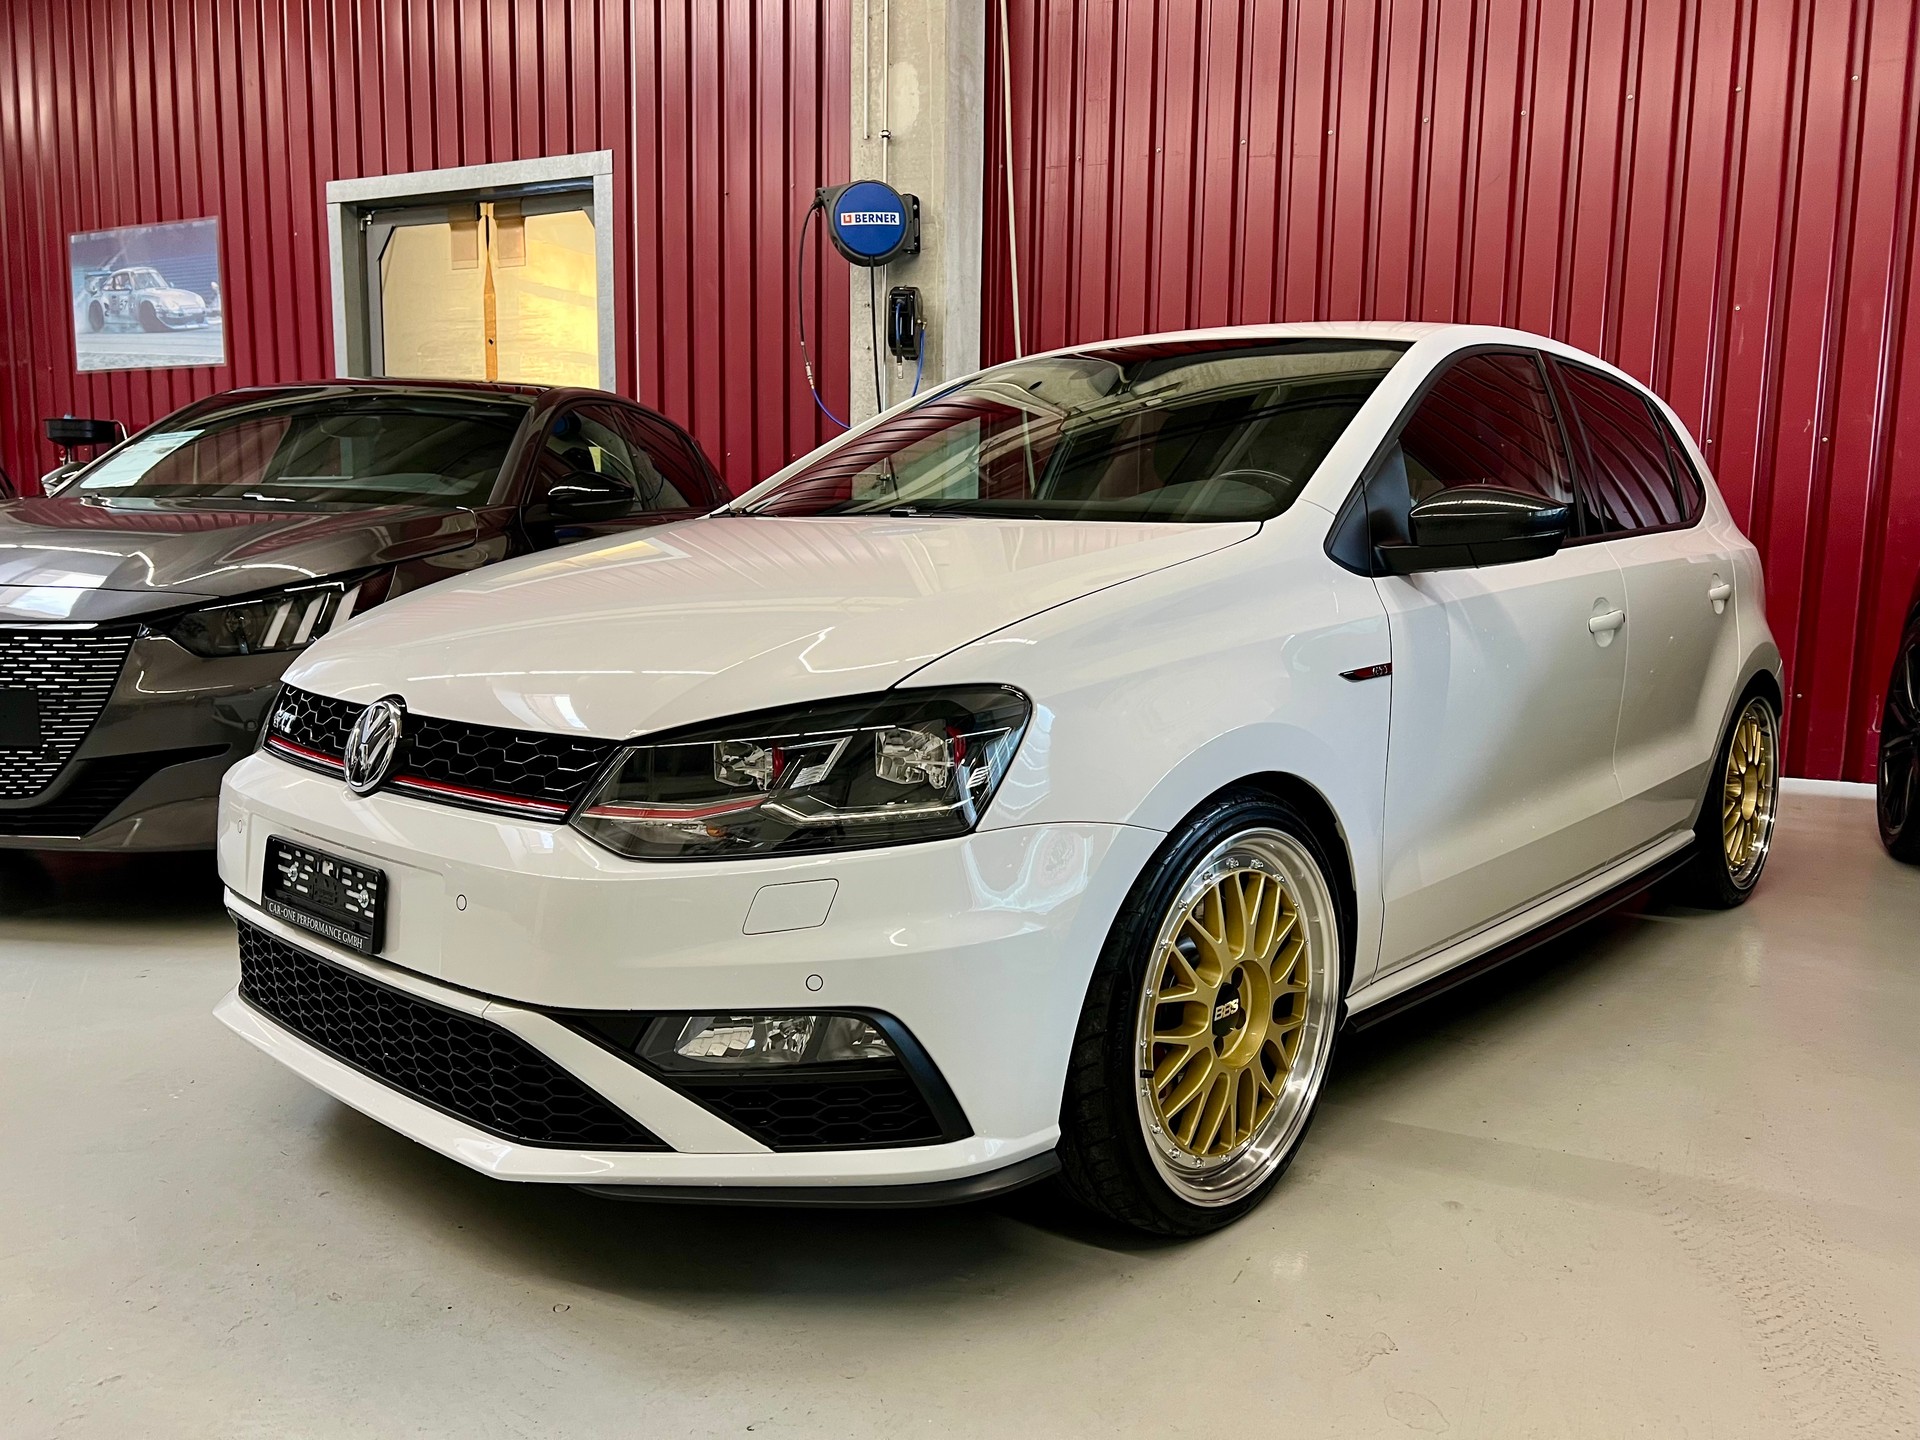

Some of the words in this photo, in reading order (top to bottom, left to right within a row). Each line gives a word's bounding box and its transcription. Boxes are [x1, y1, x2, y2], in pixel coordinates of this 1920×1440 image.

[855, 213, 897, 224] BERNER
[268, 902, 296, 922] CAR-ONE
[296, 912, 342, 940] PERFORMANCE
[342, 932, 363, 949] GMBH
[1214, 998, 1239, 1021] BBS
